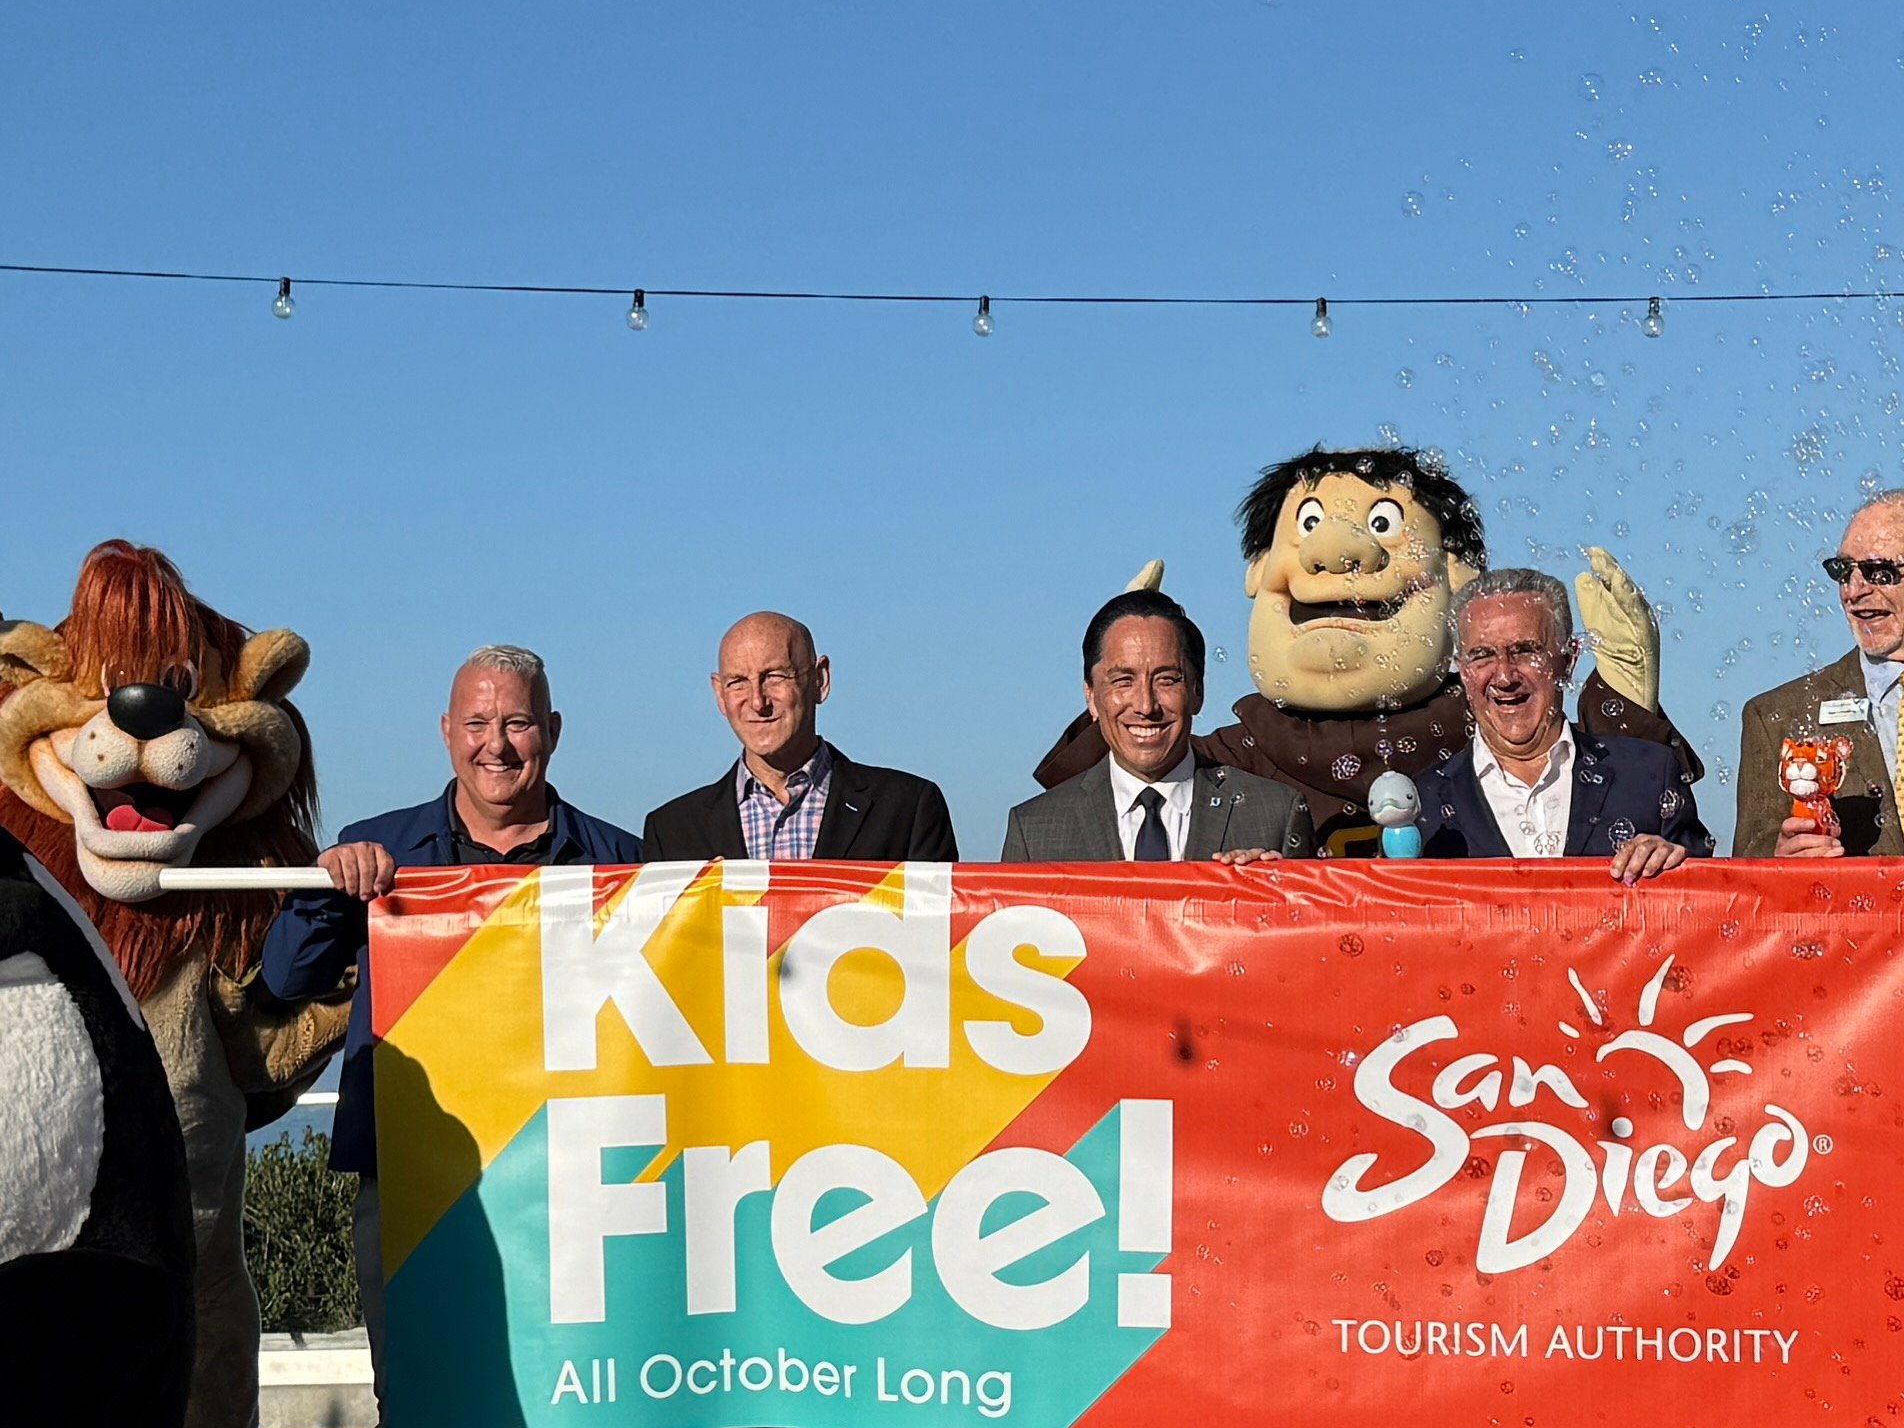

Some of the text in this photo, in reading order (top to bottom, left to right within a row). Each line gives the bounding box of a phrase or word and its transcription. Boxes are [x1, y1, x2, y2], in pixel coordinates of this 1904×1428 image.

[539, 858, 1092, 1076] Kids
[546, 1093, 1174, 1331] Free!
[1321, 1015, 1588, 1223] San
[1468, 1103, 1808, 1275] Diego
[551, 1348, 1013, 1419] All October Long
[1332, 1319, 1800, 1364] TOURISM AUTHORITY
